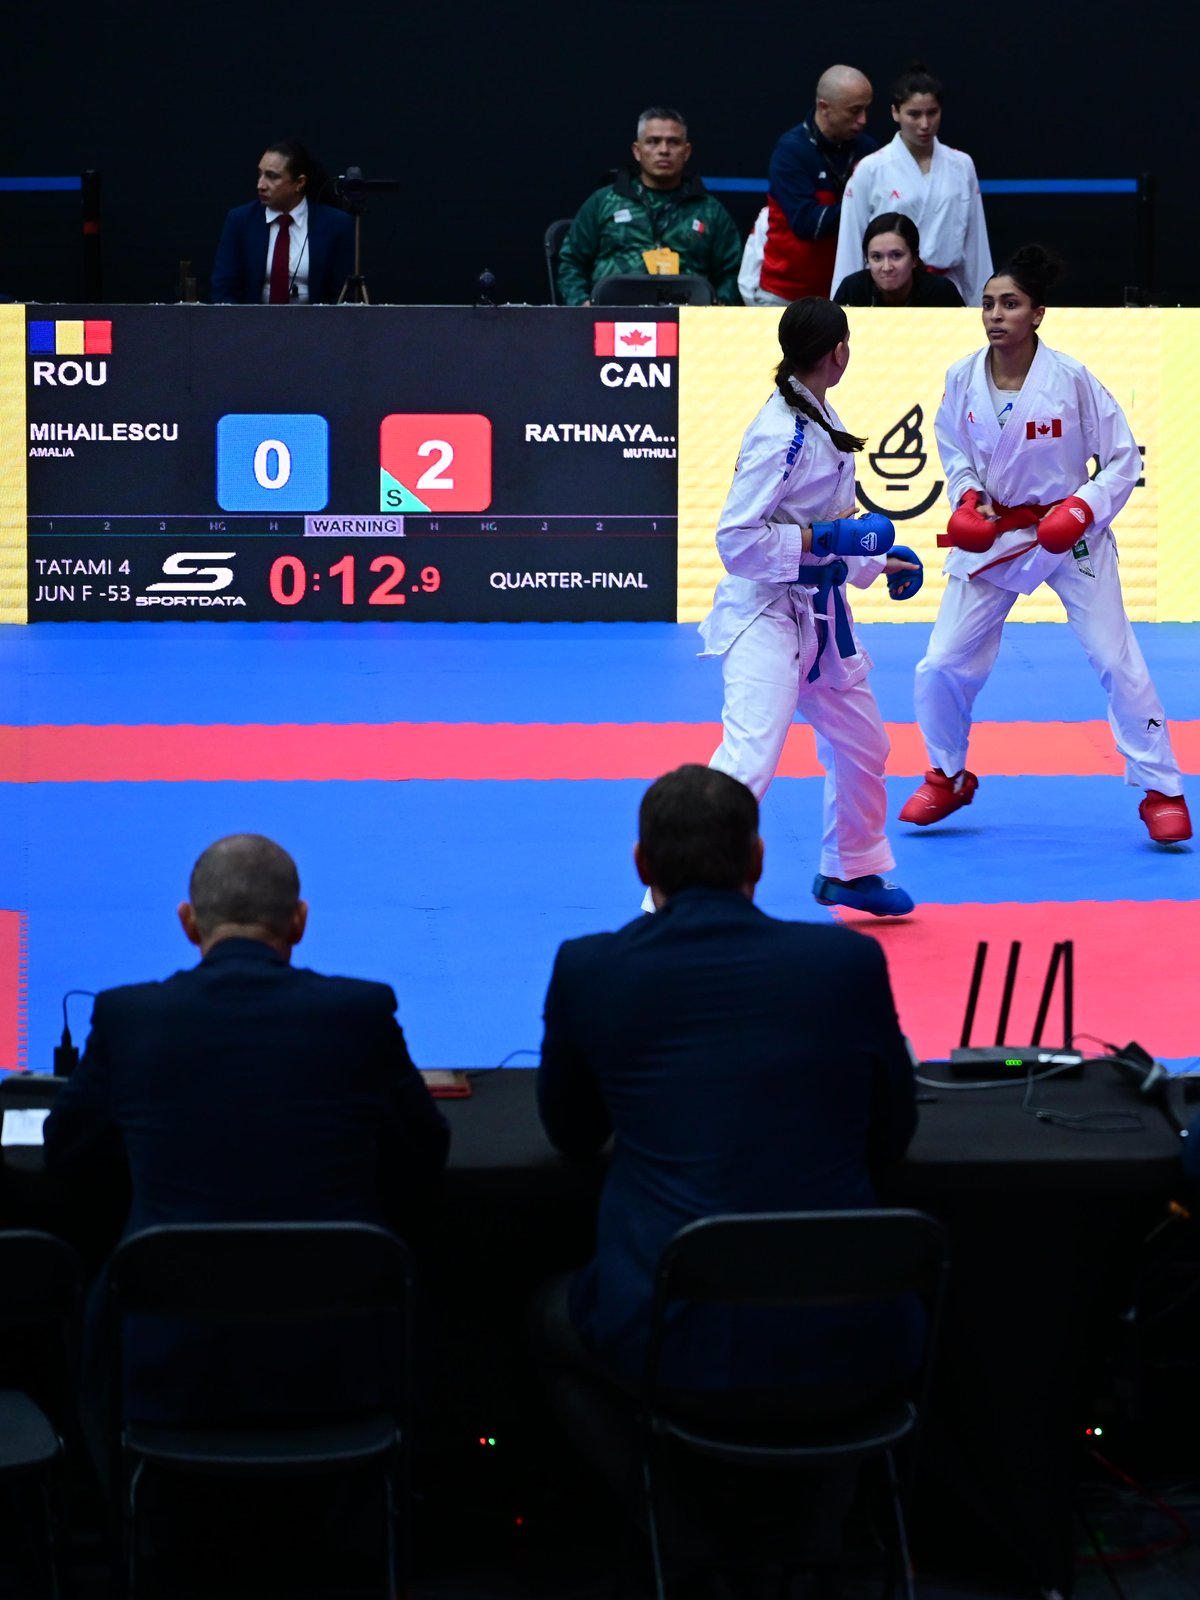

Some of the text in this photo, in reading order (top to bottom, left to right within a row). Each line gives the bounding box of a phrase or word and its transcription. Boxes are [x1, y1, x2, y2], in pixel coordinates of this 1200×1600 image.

[33, 361, 107, 387] ROU
[599, 362, 671, 388] CAN
[30, 422, 179, 441] MIHAILESCU
[525, 423, 676, 443] RATHNAYA...
[29, 448, 74, 458] AMALIA
[623, 448, 677, 459] MUTHULI
[254, 440, 291, 489] 0
[416, 440, 454, 489] 2
[386, 489, 402, 507] S
[103, 521, 111, 531] 2
[159, 521, 166, 531] 3
[209, 521, 226, 531] HG
[269, 521, 278, 531] H
[313, 520, 397, 533] WARNING
[430, 521, 439, 531] H
[480, 521, 498, 531] HG
[541, 521, 548, 531] 3
[596, 521, 604, 531] 2
[35, 559, 131, 576] TATAMI 4
[489, 571, 648, 591] QUARTER-FINAL
[35, 585, 131, 602] JUN F -53
[135, 596, 247, 607] SPORTDATA
